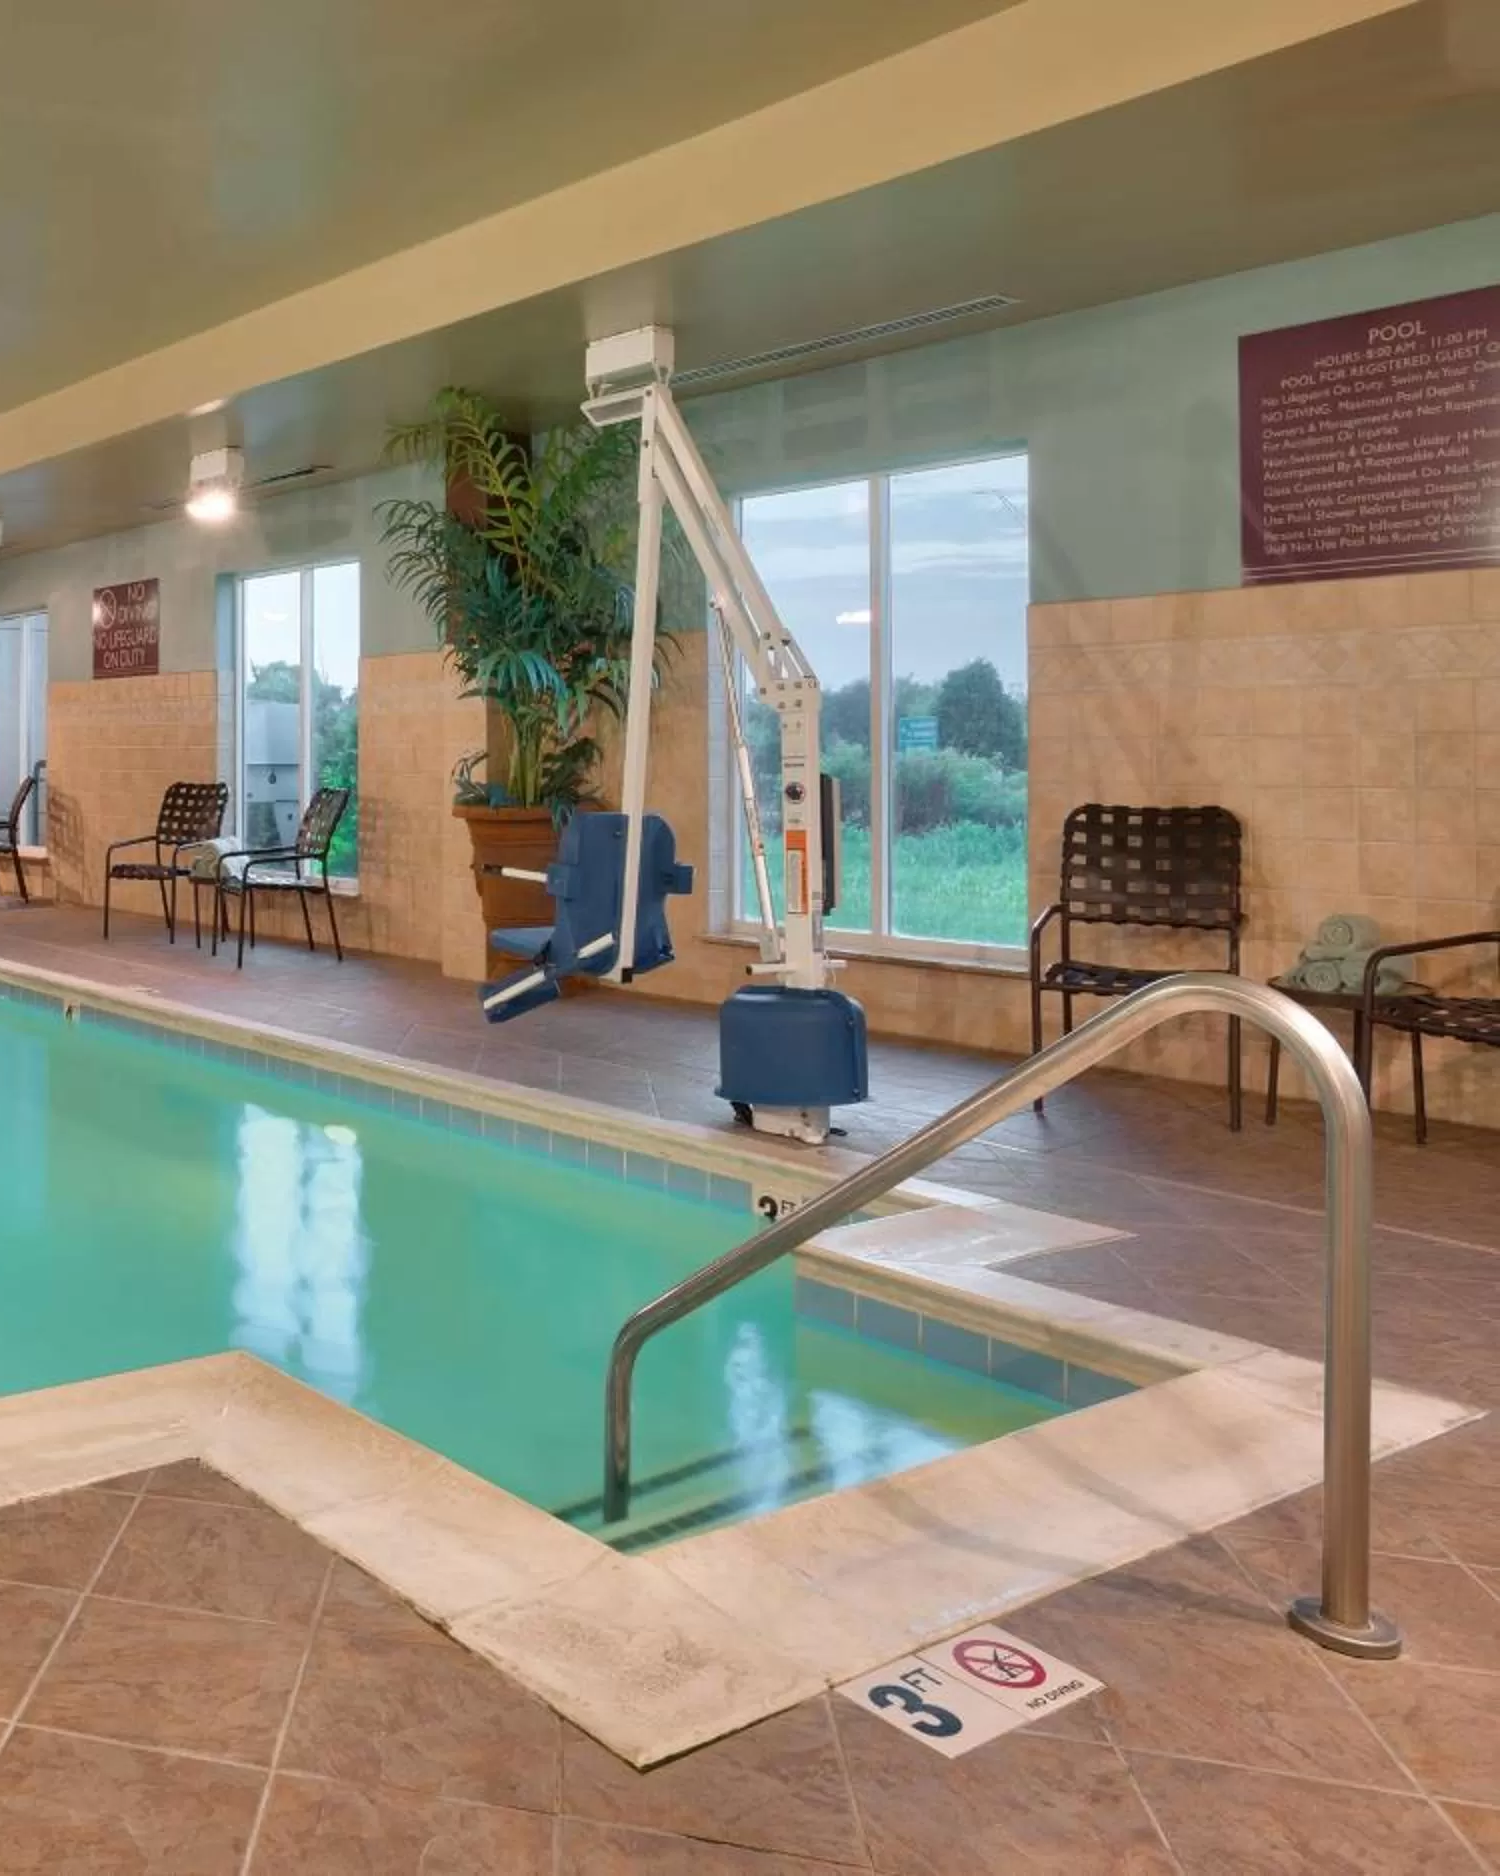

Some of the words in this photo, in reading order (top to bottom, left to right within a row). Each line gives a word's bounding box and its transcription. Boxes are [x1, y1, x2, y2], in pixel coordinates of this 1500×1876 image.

[1368, 320, 1427, 346] POOL
[1430, 333, 1463, 349] 11:00
[1467, 328, 1488, 342] PM
[1280, 375, 1316, 390] POOL
[1319, 370, 1345, 383] FOR
[1350, 355, 1431, 378] REGISTERED
[1435, 346, 1481, 364] GUEST
[1260, 412, 1283, 424] NO
[126, 583, 146, 602] NO
[103, 651, 119, 669] ON
[119, 647, 146, 667] DUTY
[900, 1667, 944, 1693] FT
[1026, 1697, 1047, 1709] NO
[1044, 1680, 1085, 1701] DIVING
[868, 1684, 963, 1738] 3
